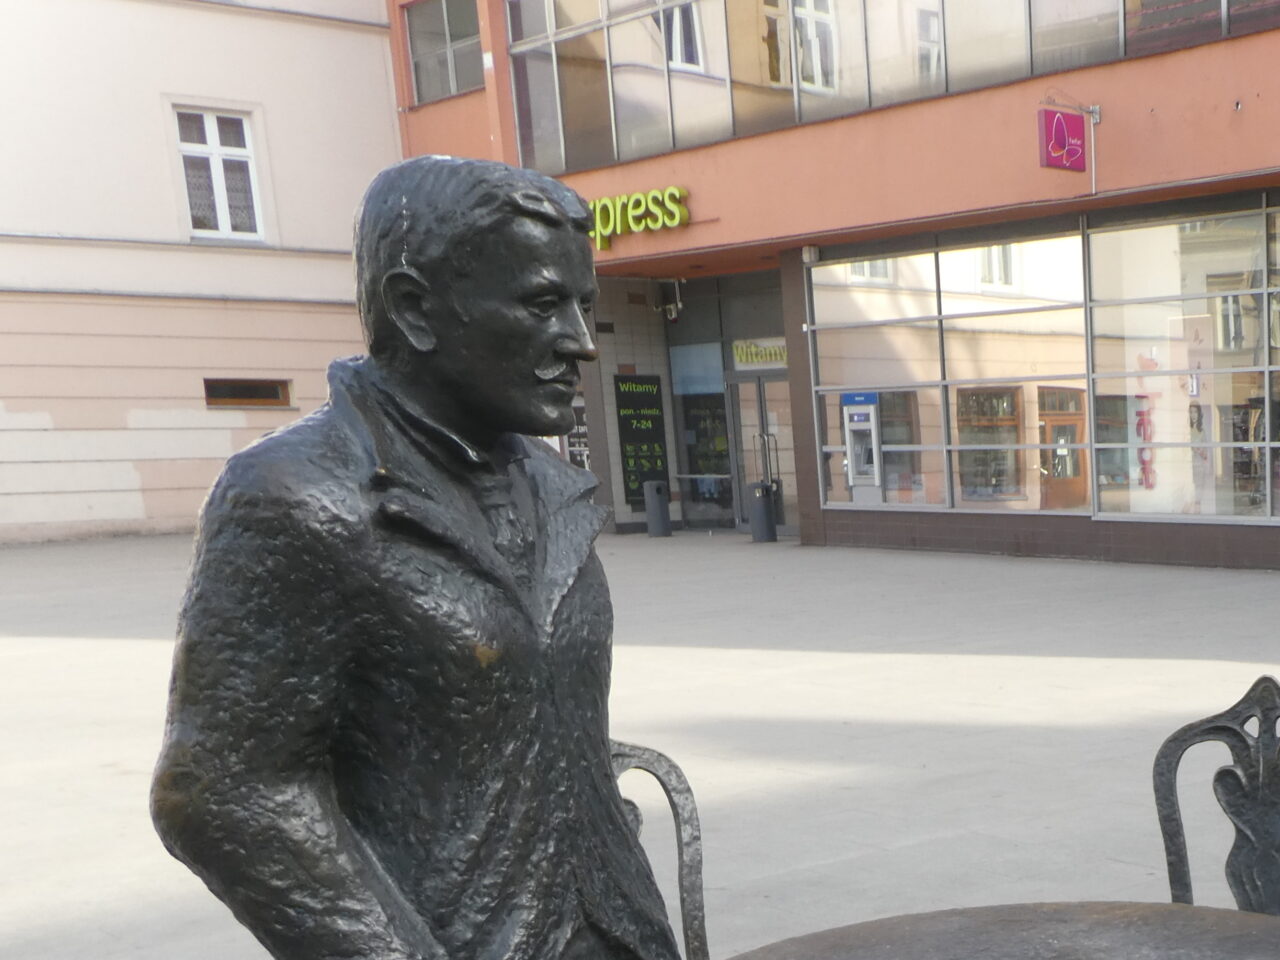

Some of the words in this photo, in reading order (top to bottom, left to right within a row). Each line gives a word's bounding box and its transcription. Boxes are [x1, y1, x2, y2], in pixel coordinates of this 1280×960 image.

[732, 343, 788, 366] Witamy
[619, 382, 658, 395] Witamy
[632, 420, 652, 430] 7-24
